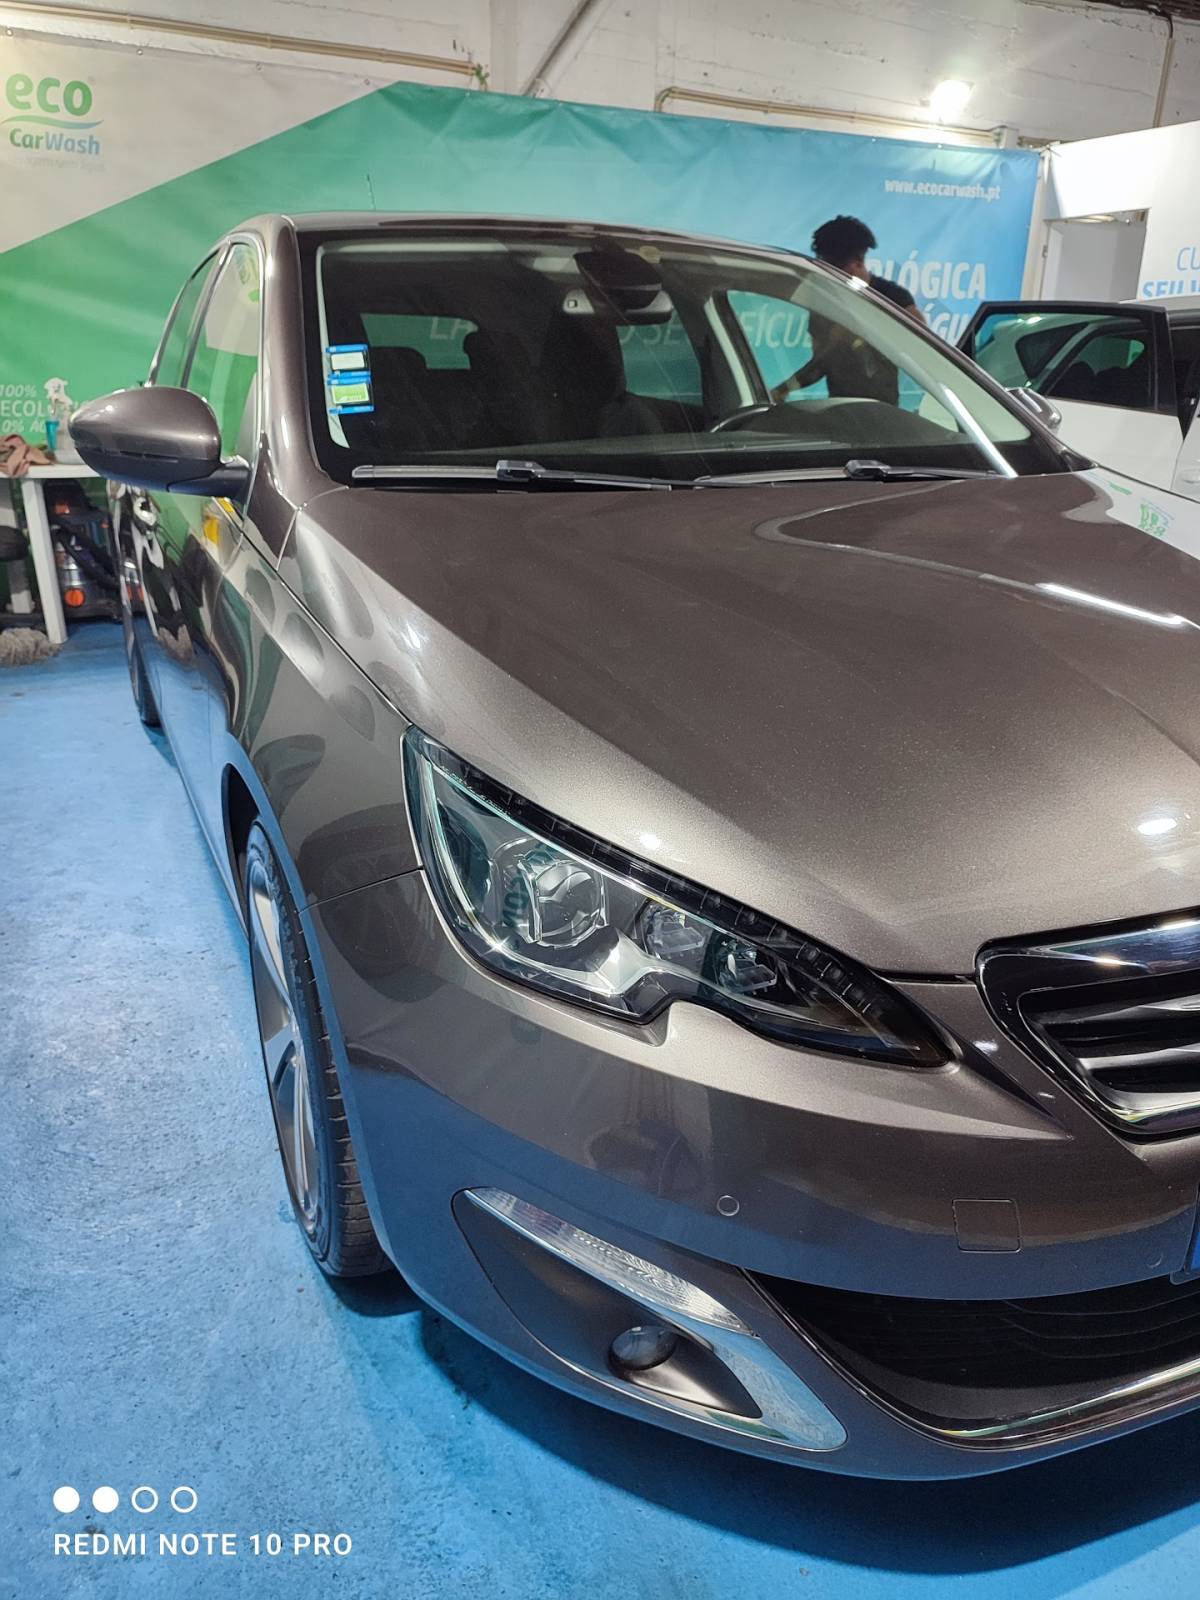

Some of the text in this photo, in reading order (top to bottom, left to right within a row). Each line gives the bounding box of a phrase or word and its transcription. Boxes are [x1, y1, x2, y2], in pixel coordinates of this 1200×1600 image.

[6, 73, 93, 116] eco
[9, 128, 100, 155] CarWash
[885, 180, 1001, 203] www.ecocarwash.pt
